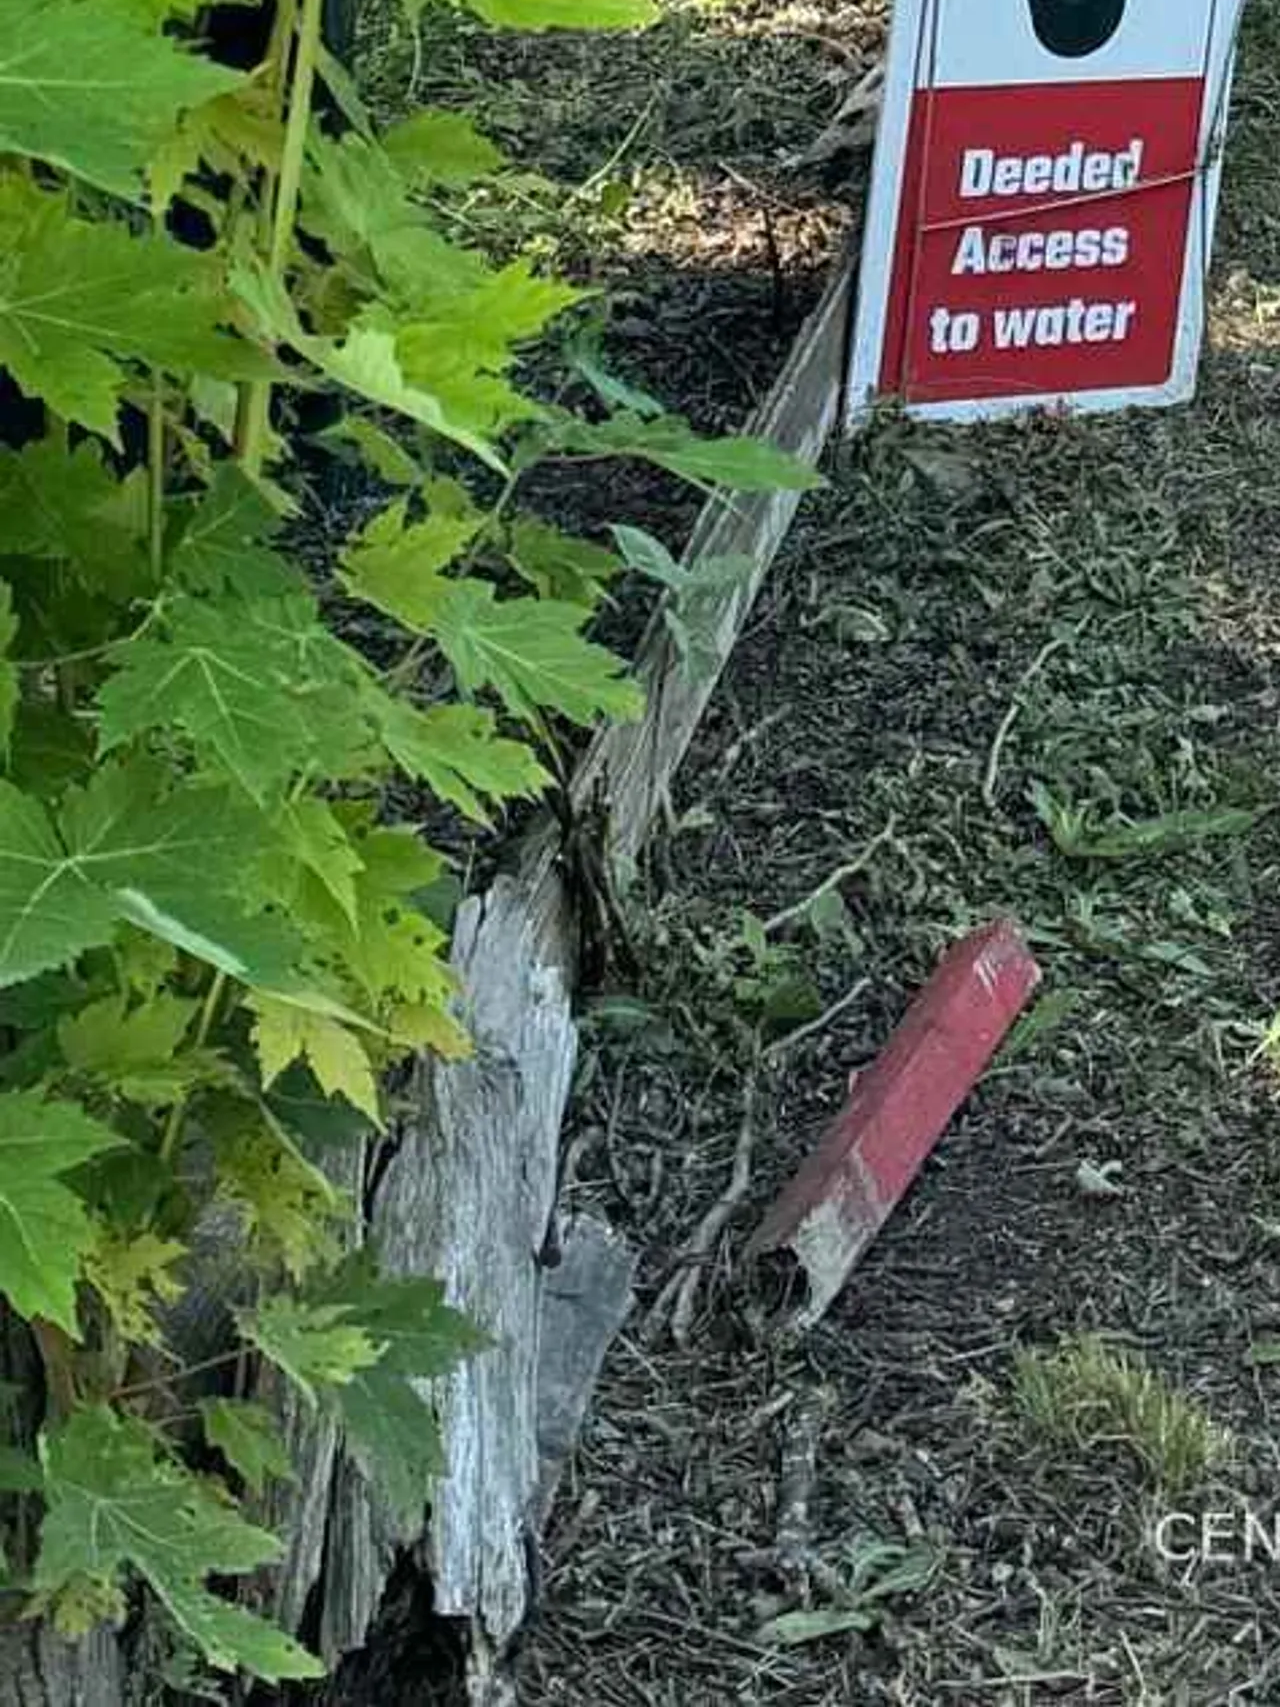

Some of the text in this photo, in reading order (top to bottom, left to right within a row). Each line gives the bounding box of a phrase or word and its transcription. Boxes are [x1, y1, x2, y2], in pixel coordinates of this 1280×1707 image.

[960, 138, 1143, 197] Deeded
[952, 226, 1128, 275] Access
[929, 298, 1136, 353] to water
